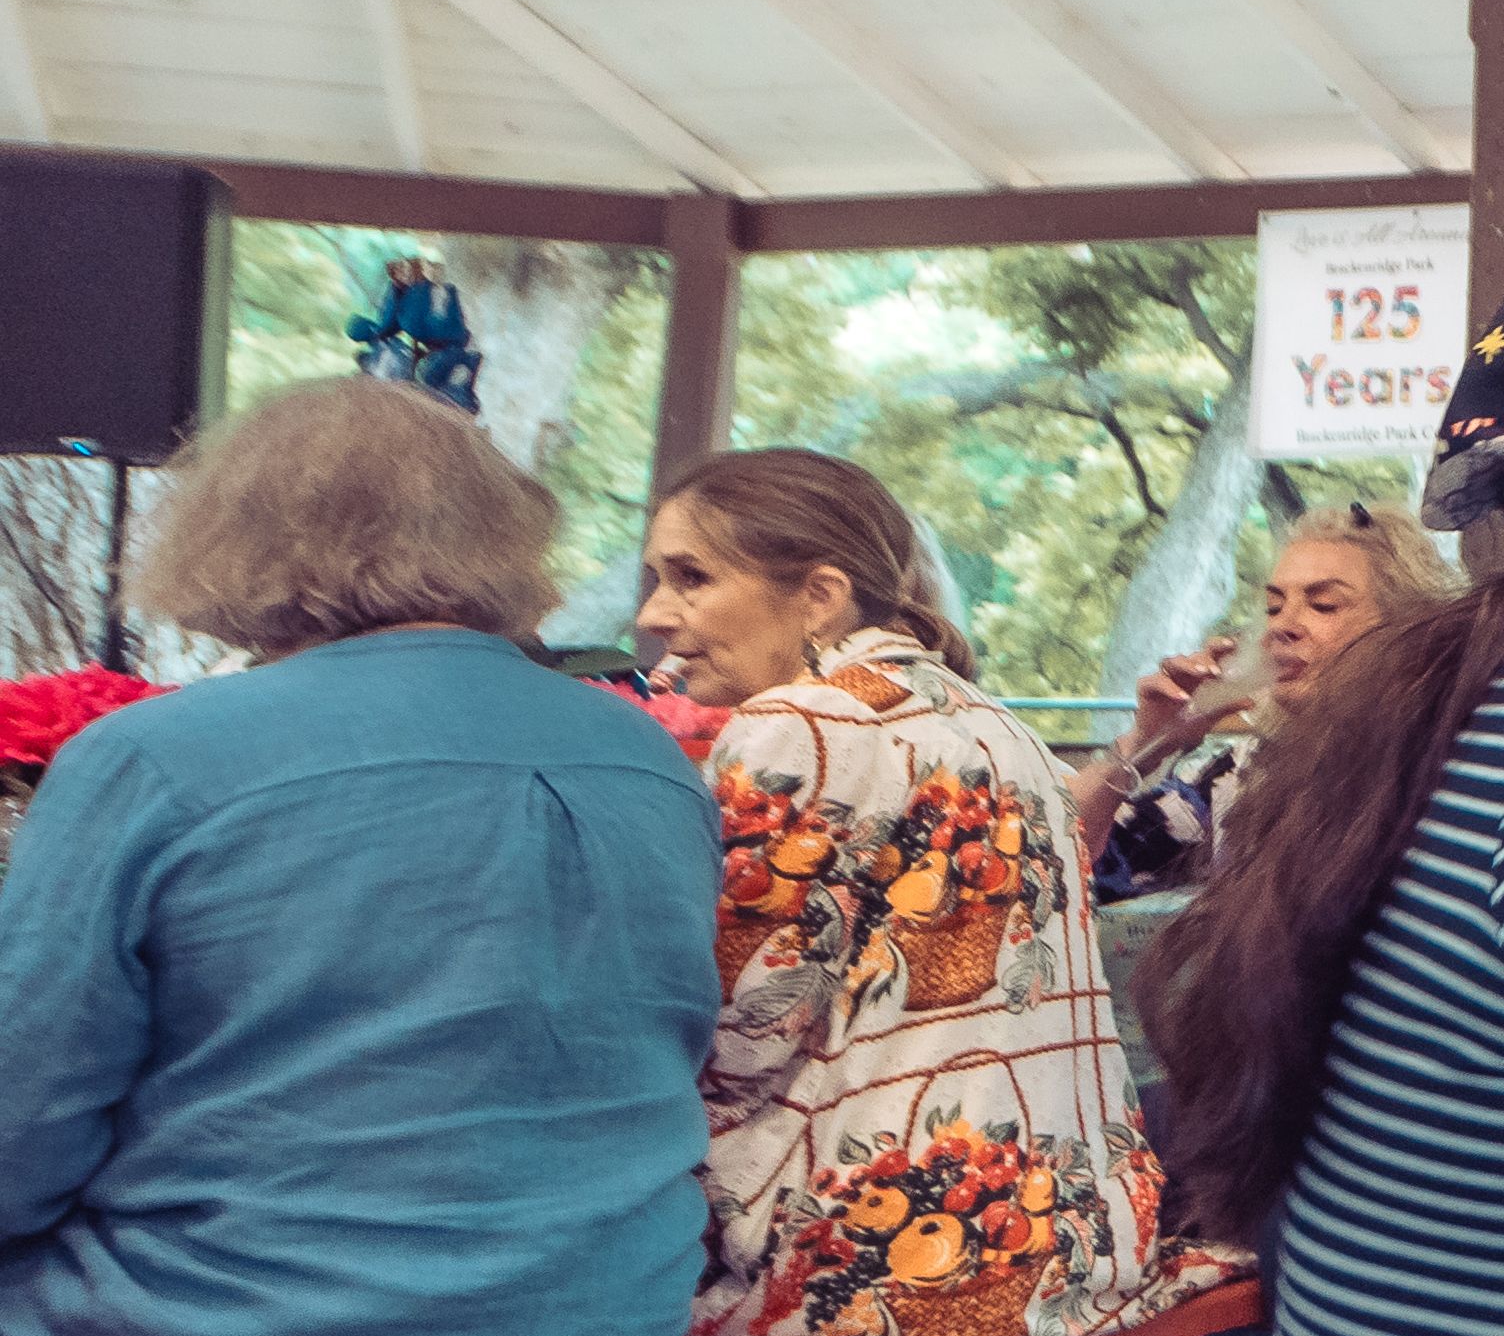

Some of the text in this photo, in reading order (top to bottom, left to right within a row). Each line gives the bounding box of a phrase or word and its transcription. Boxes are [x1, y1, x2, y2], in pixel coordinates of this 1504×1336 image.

[1406, 255, 1434, 272] Park
[1326, 285, 1422, 342] 125
[1291, 353, 1453, 408] Years
[1385, 423, 1417, 440] Park
